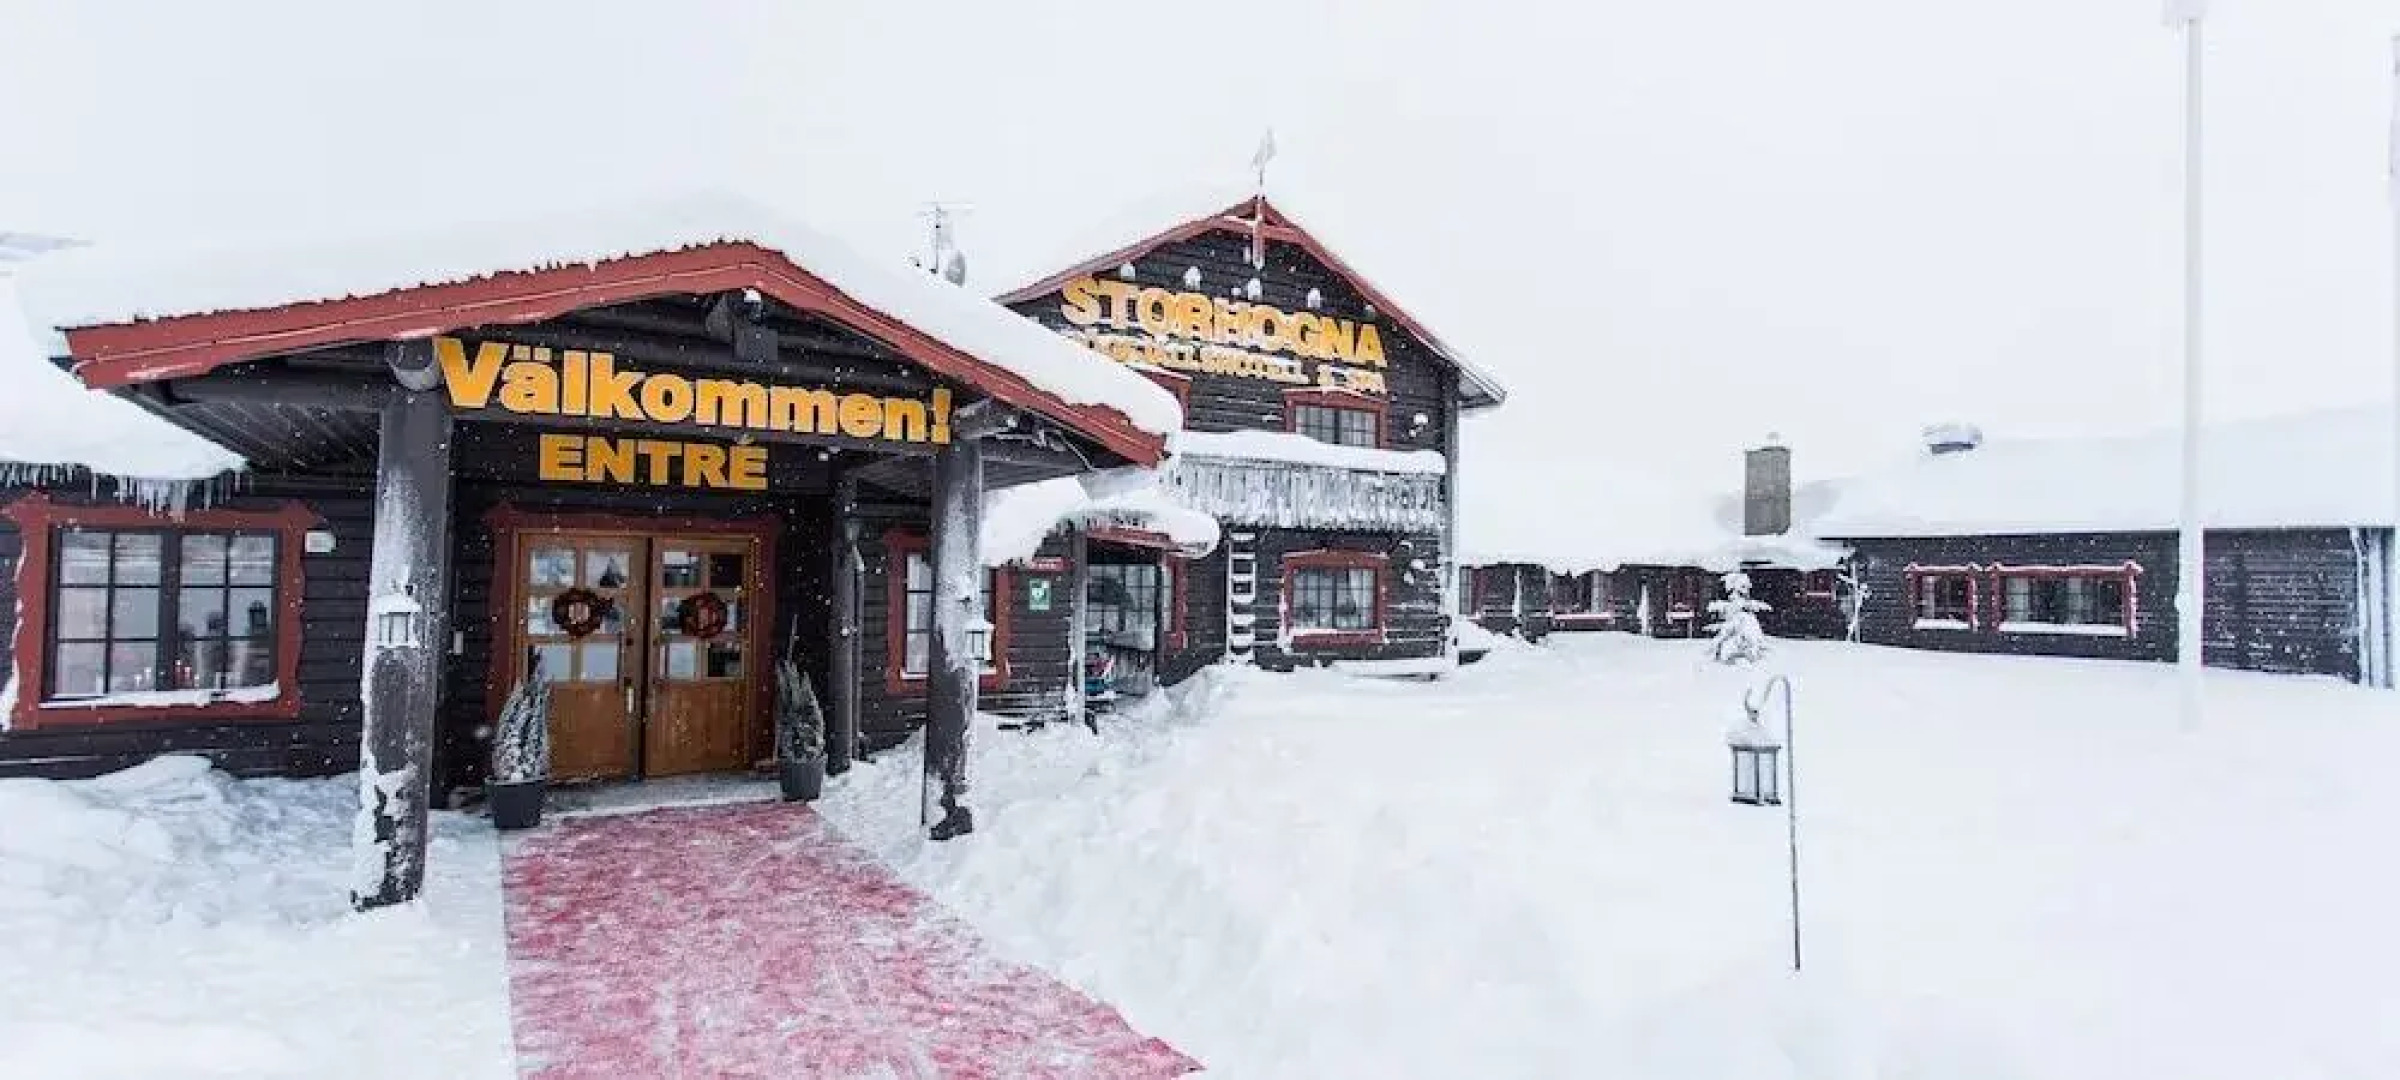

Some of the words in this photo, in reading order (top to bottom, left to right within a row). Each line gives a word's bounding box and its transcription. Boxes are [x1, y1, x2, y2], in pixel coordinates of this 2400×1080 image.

[1061, 275, 1388, 367] STORHOGNA
[433, 337, 951, 444] Välkommen!
[539, 434, 768, 491] ENTRÉ
